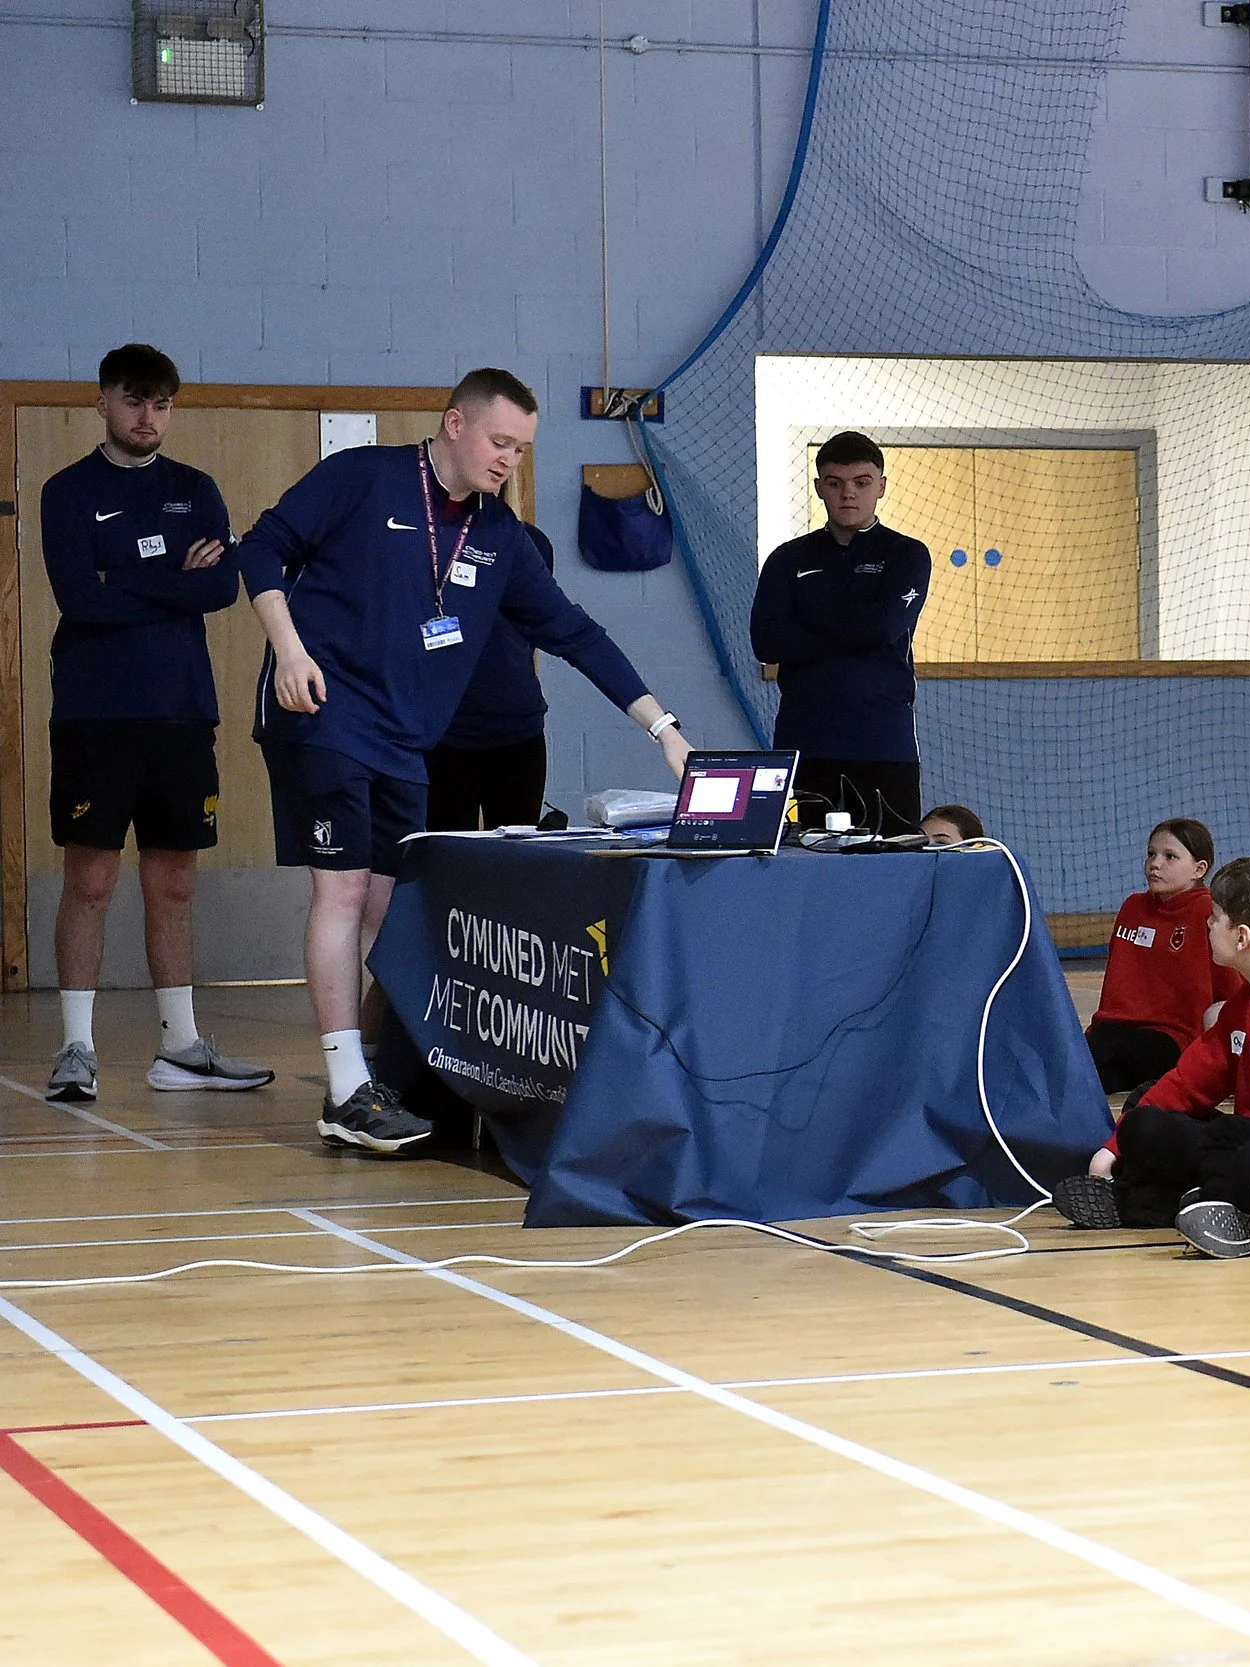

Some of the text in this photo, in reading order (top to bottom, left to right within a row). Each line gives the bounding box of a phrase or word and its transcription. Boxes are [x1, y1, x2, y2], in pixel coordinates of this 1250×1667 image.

[448, 907, 594, 1005] CYMUNED MET
[427, 1046, 480, 1081] Chwaraeon
[480, 1061, 494, 1087] Met
